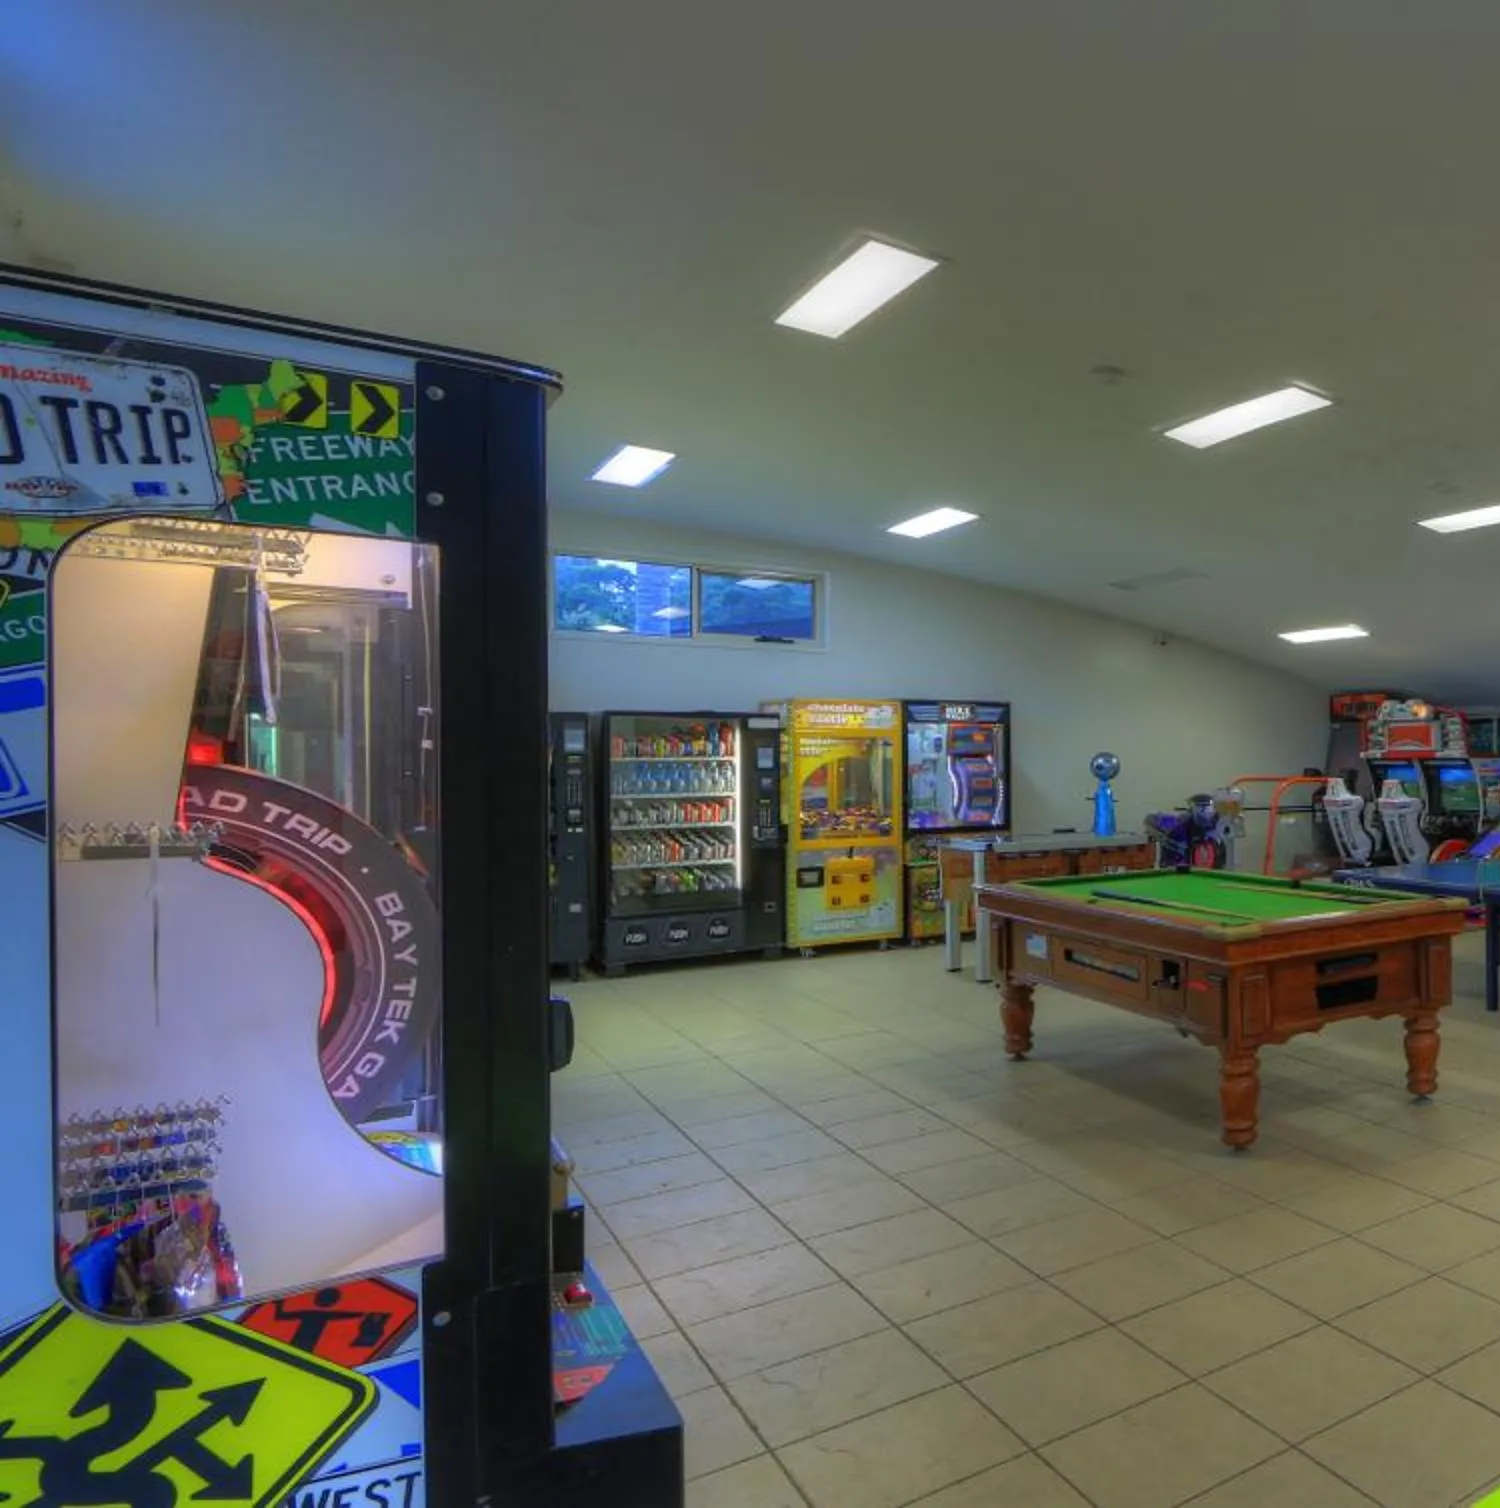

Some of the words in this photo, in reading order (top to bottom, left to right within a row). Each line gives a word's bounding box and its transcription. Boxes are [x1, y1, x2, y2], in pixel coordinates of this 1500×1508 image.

[39, 395, 192, 465] TRIP
[262, 800, 353, 855] TRIP
[374, 891, 418, 965] BAY
[373, 975, 418, 1046] TEK
